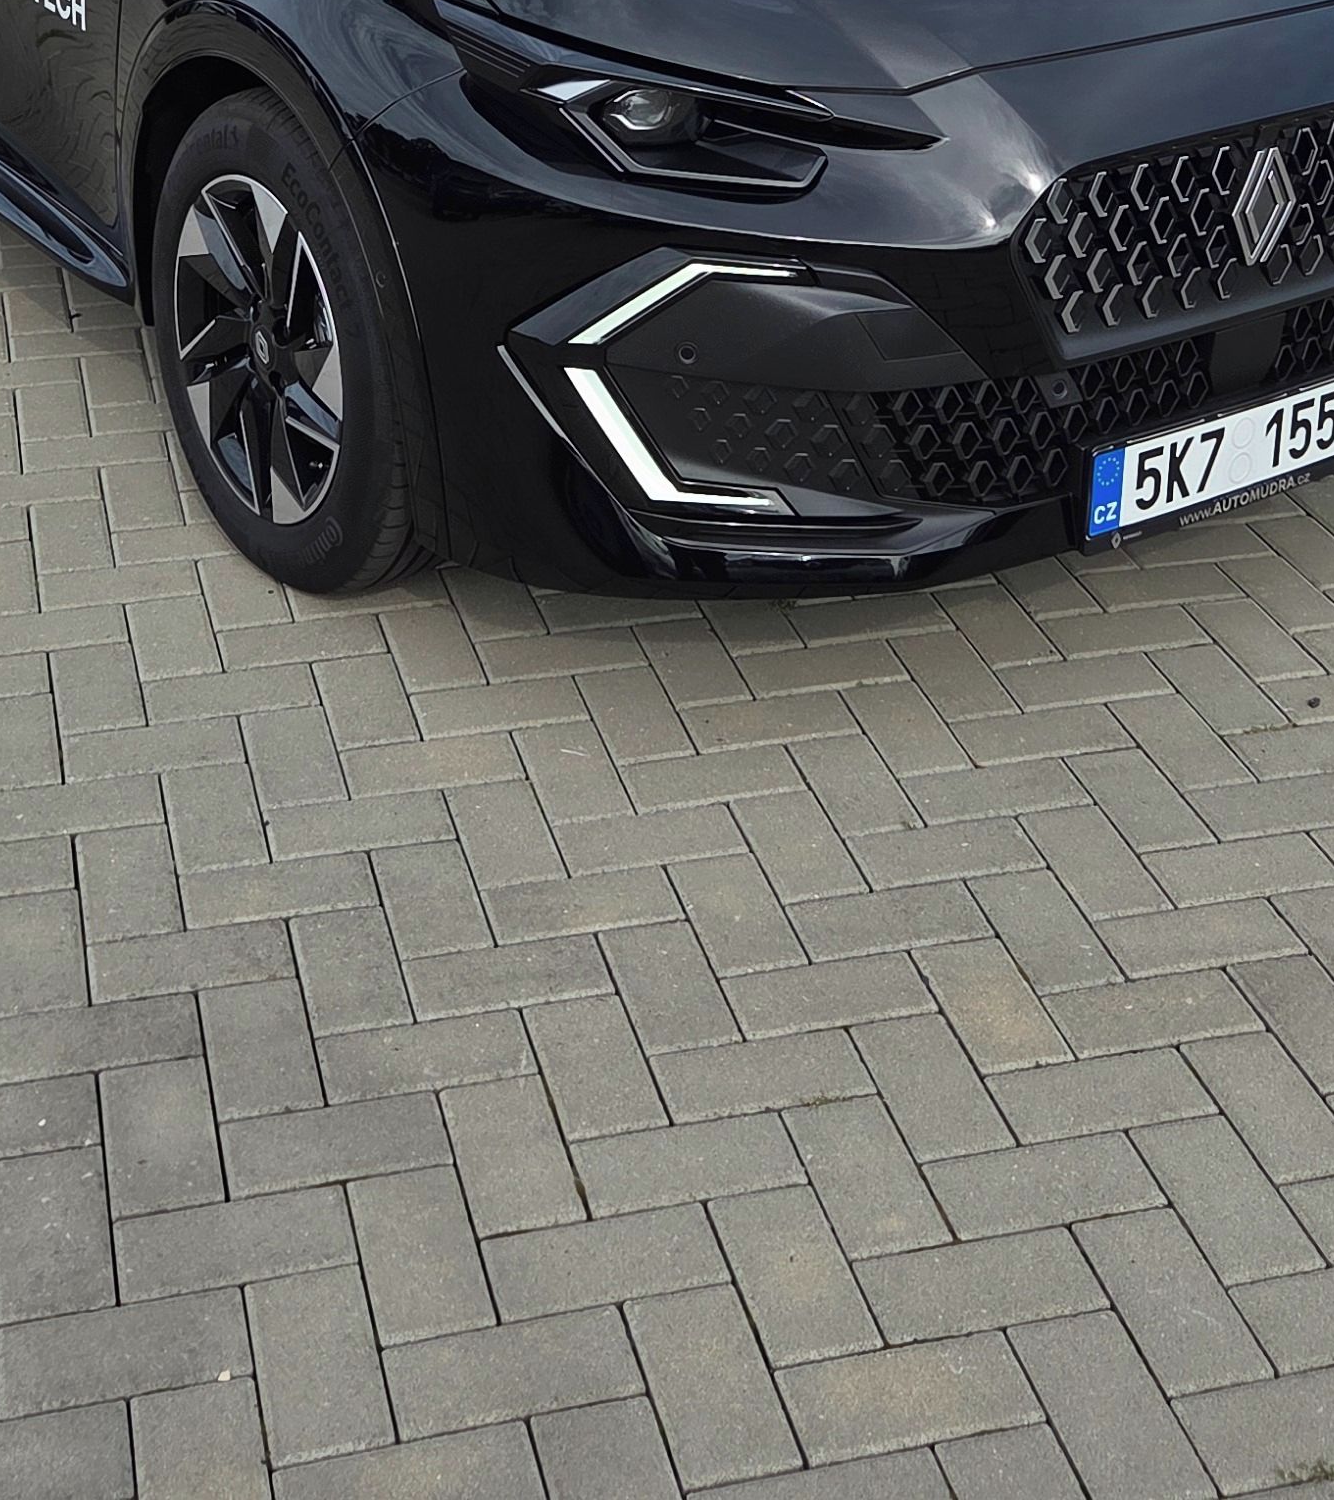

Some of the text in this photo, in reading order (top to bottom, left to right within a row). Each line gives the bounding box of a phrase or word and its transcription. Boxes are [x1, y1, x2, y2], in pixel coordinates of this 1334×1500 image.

[1135, 427, 1226, 511] 5K7
[1093, 501, 1118, 525] CZ
[1178, 472, 1312, 527] www.AUTOMUDRA.cz
